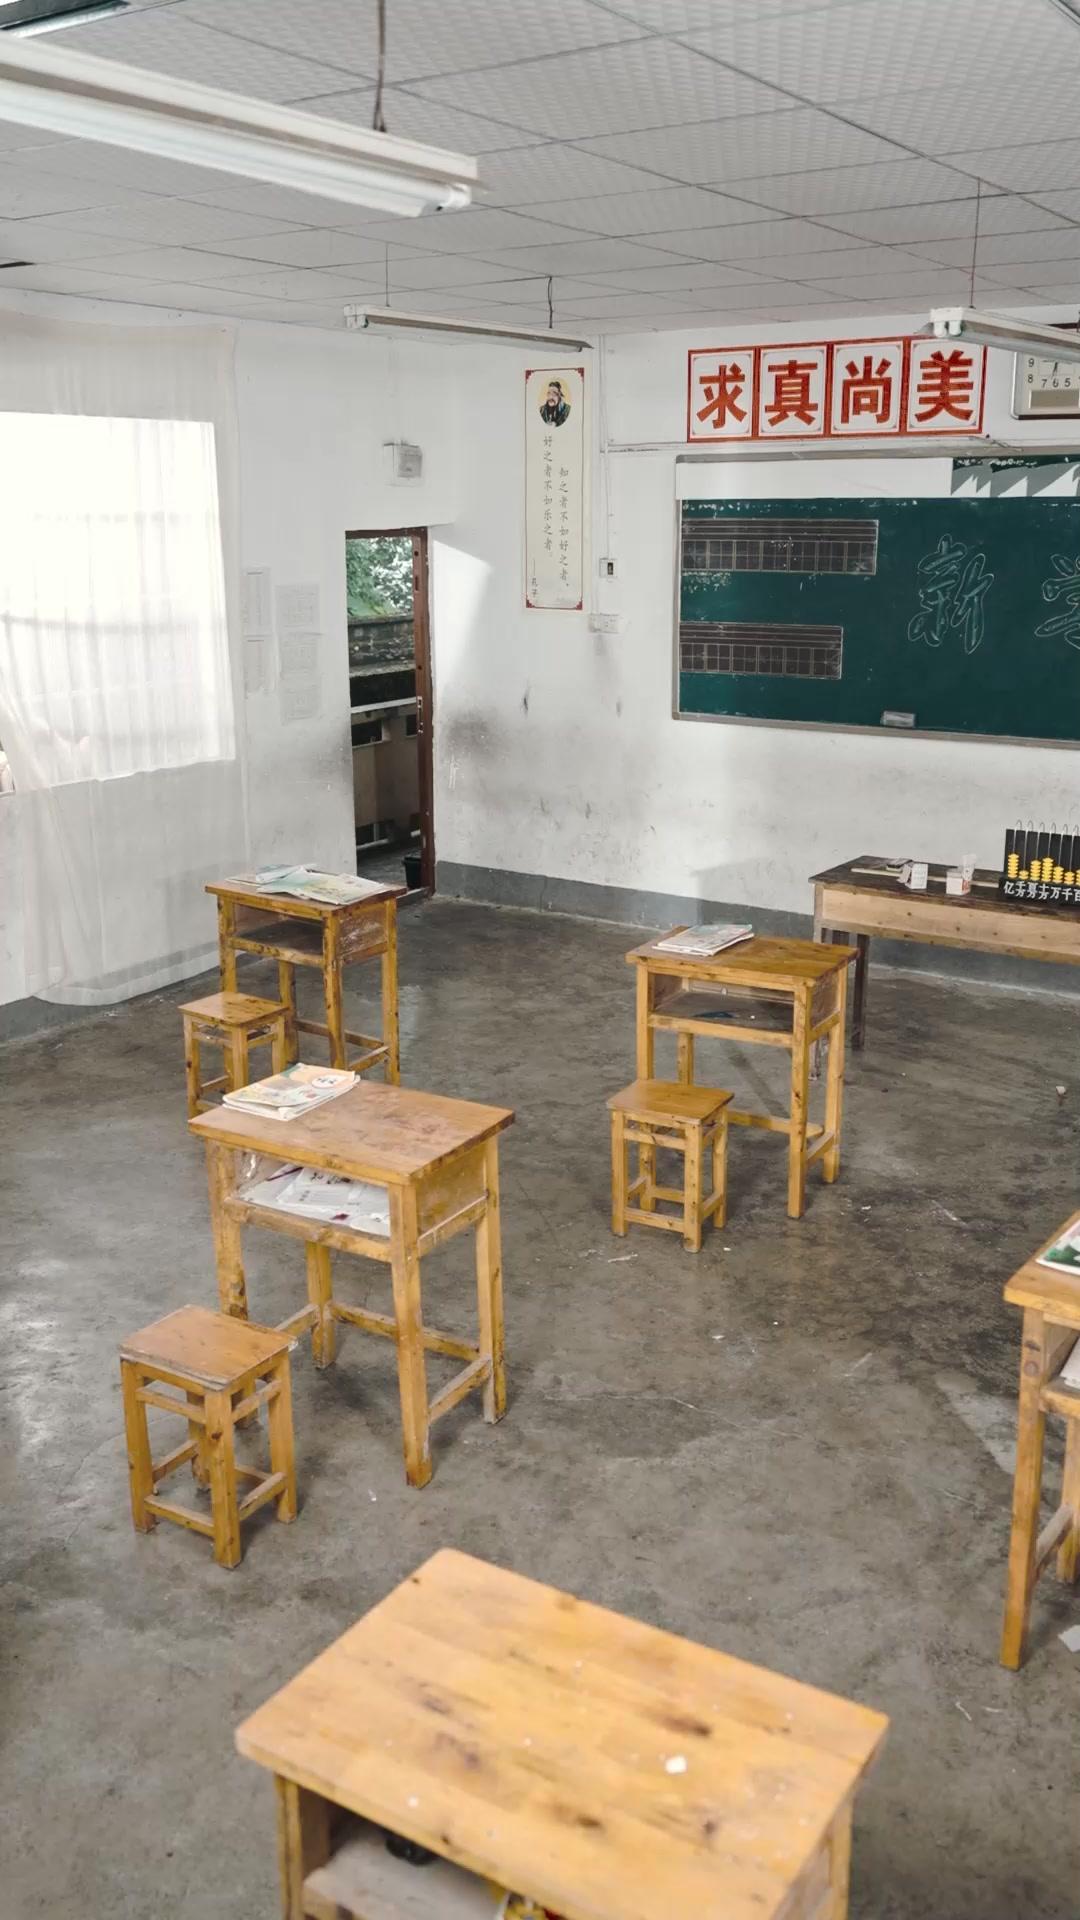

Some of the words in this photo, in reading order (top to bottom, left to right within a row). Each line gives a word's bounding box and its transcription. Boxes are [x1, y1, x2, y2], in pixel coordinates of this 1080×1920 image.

[1028, 357, 1035, 368] 9
[1027, 374, 1034, 384] 8
[1041, 378, 1048, 388] 7
[1064, 377, 1071, 388] 5
[696, 349, 975, 430] 求真尚美
